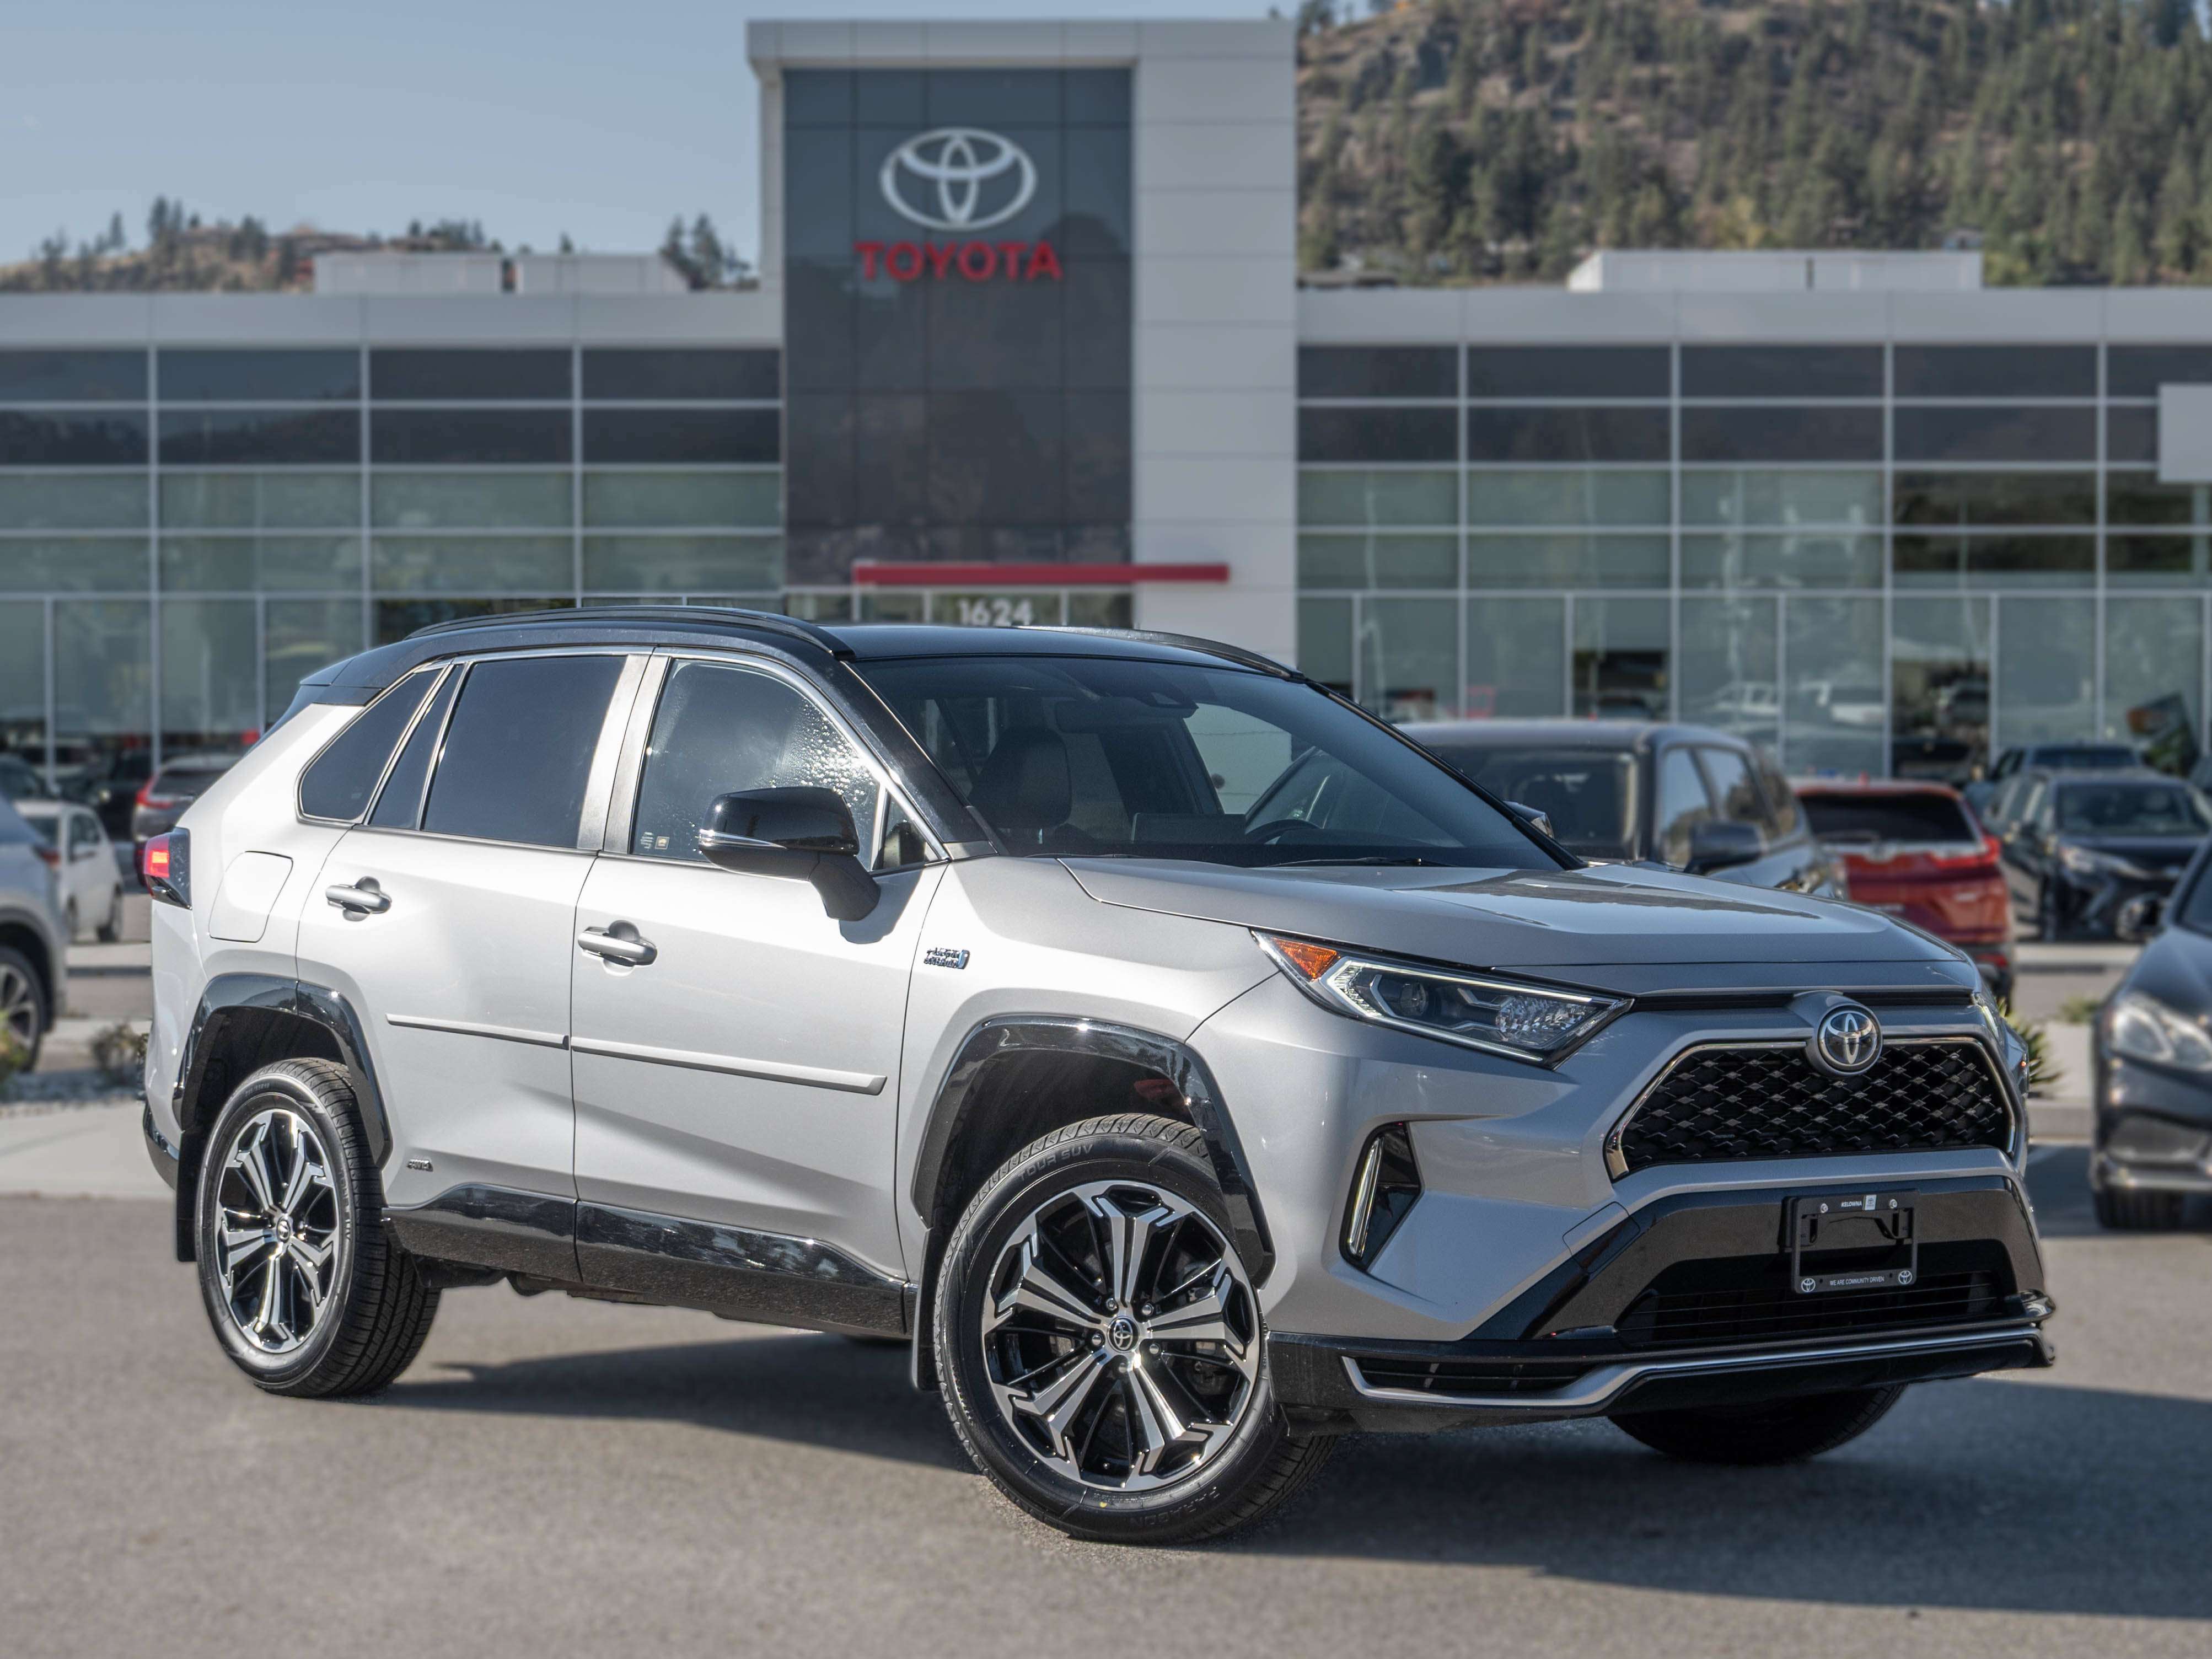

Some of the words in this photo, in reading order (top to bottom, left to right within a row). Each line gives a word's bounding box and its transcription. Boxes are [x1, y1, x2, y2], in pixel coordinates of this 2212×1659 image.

[853, 240, 1064, 282] TOYOTA
[958, 598, 1033, 626] 1624
[1018, 1154, 1057, 1182] TOUR
[1061, 1144, 1094, 1159] SUV
